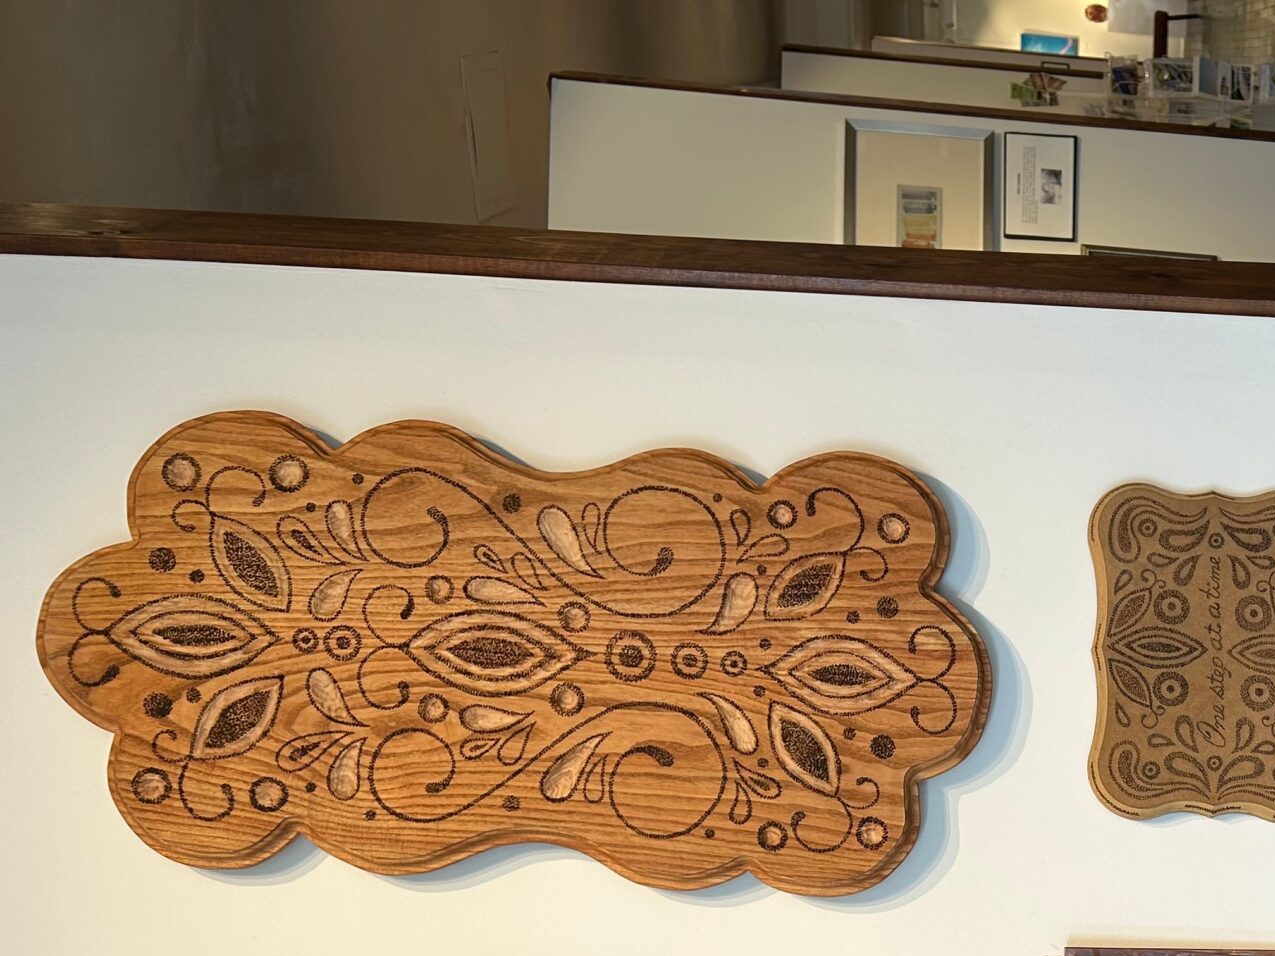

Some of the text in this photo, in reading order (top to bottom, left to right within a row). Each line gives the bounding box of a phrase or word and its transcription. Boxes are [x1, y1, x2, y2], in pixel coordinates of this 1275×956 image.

[1199, 555, 1222, 600] time
[1208, 601, 1222, 618] a
[1201, 657, 1232, 700] step
[1196, 703, 1226, 748] One
